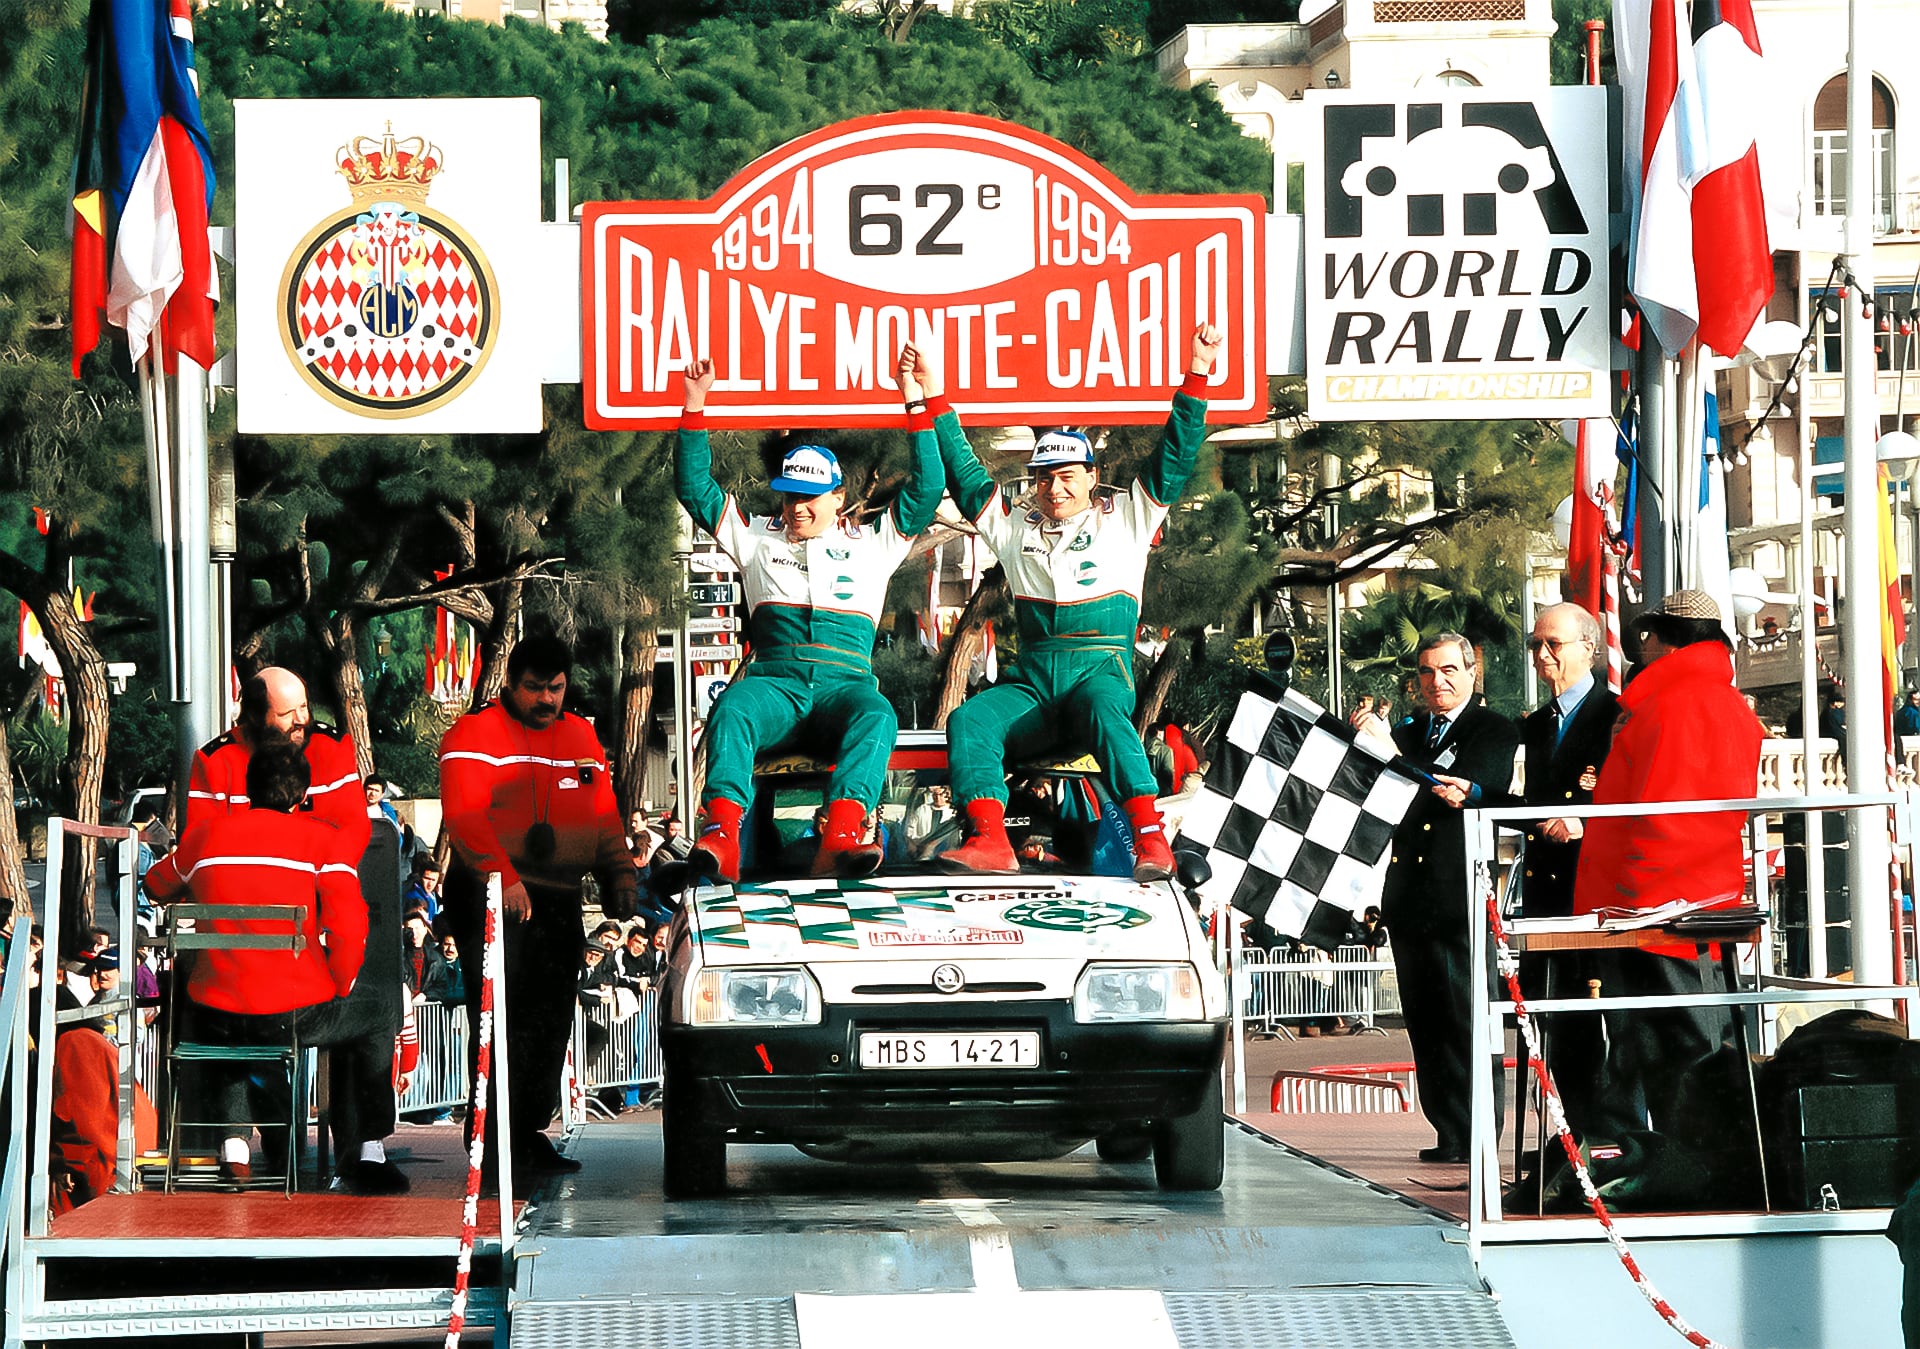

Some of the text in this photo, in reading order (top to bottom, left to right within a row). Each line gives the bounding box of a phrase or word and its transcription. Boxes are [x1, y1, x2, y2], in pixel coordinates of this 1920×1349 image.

[711, 166, 812, 270] 1994
[1035, 173, 1131, 266] 1994
[1324, 248, 1592, 299] WORLD
[619, 236, 818, 392] RALLYE
[1325, 306, 1589, 365] RALLY
[1327, 375, 1589, 400] CHAMPIONSHIP
[1037, 443, 1077, 455] MICHELIN
[784, 463, 825, 476] MICHELIN
[954, 890, 1073, 903] Castrol
[878, 1039, 1019, 1063] MBS 14-21
